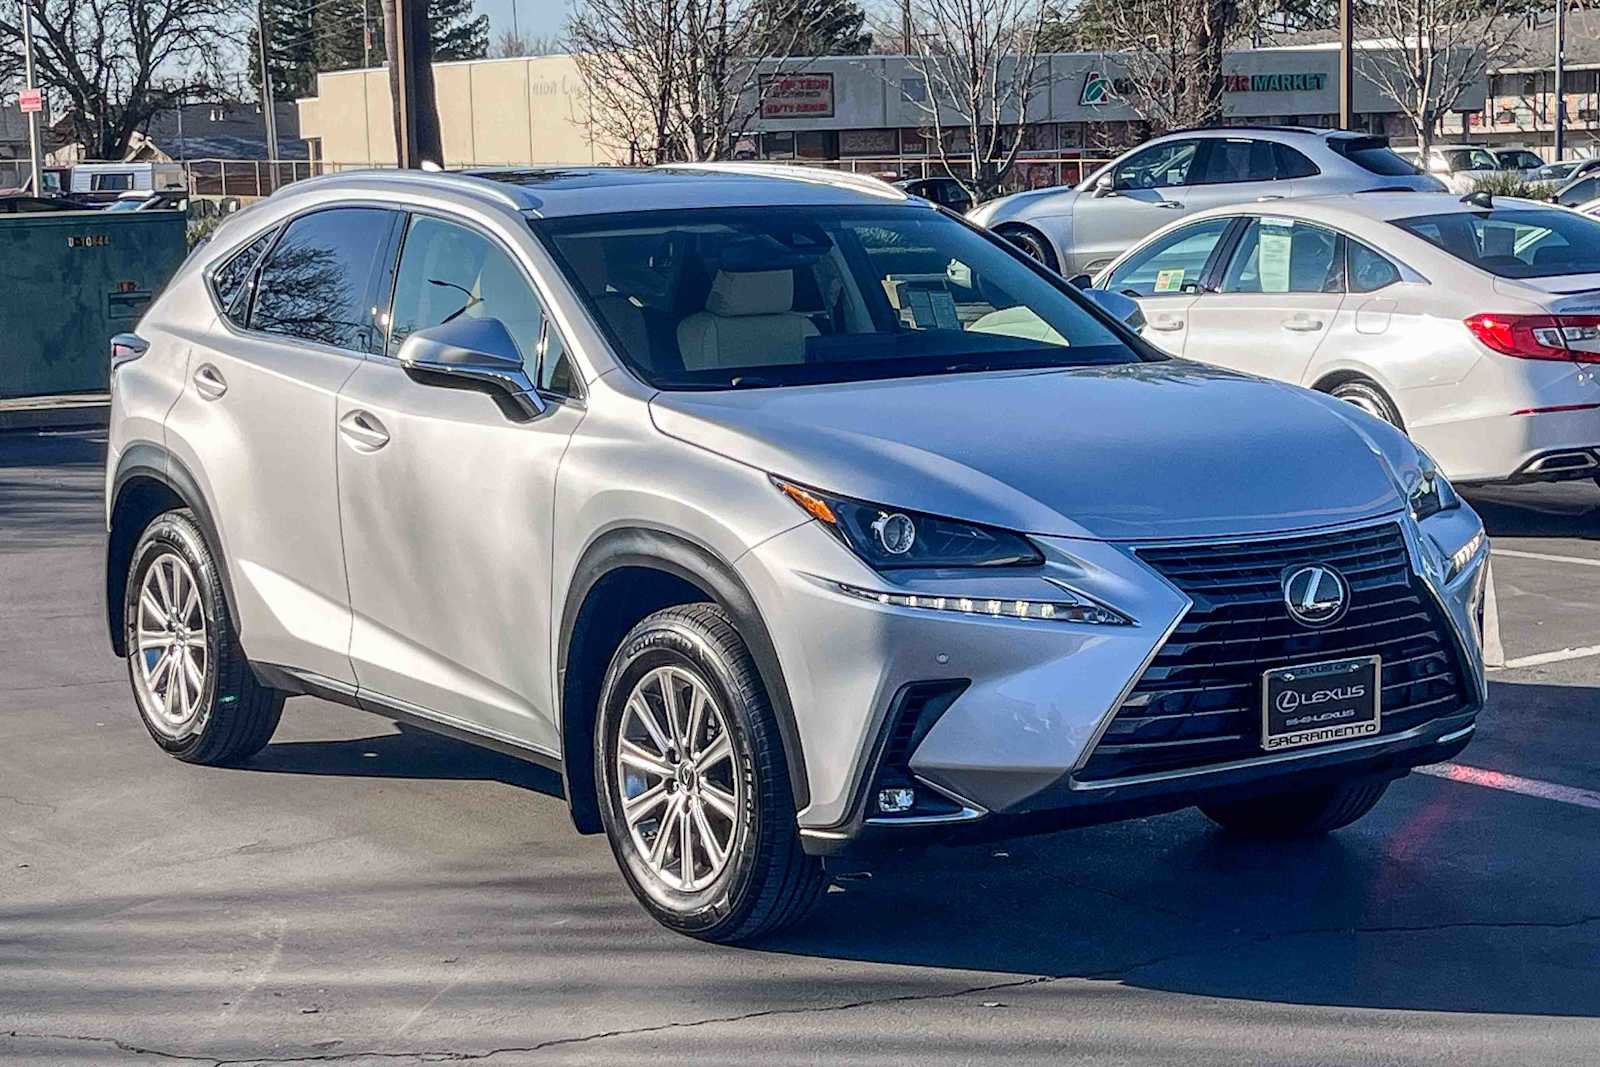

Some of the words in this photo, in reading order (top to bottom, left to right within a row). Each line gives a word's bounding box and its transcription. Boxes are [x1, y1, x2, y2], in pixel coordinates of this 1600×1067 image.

[1254, 73, 1327, 92] MARKET
[1301, 685, 1366, 705] LEXUS
[1268, 723, 1377, 748] SACRAMENTO
